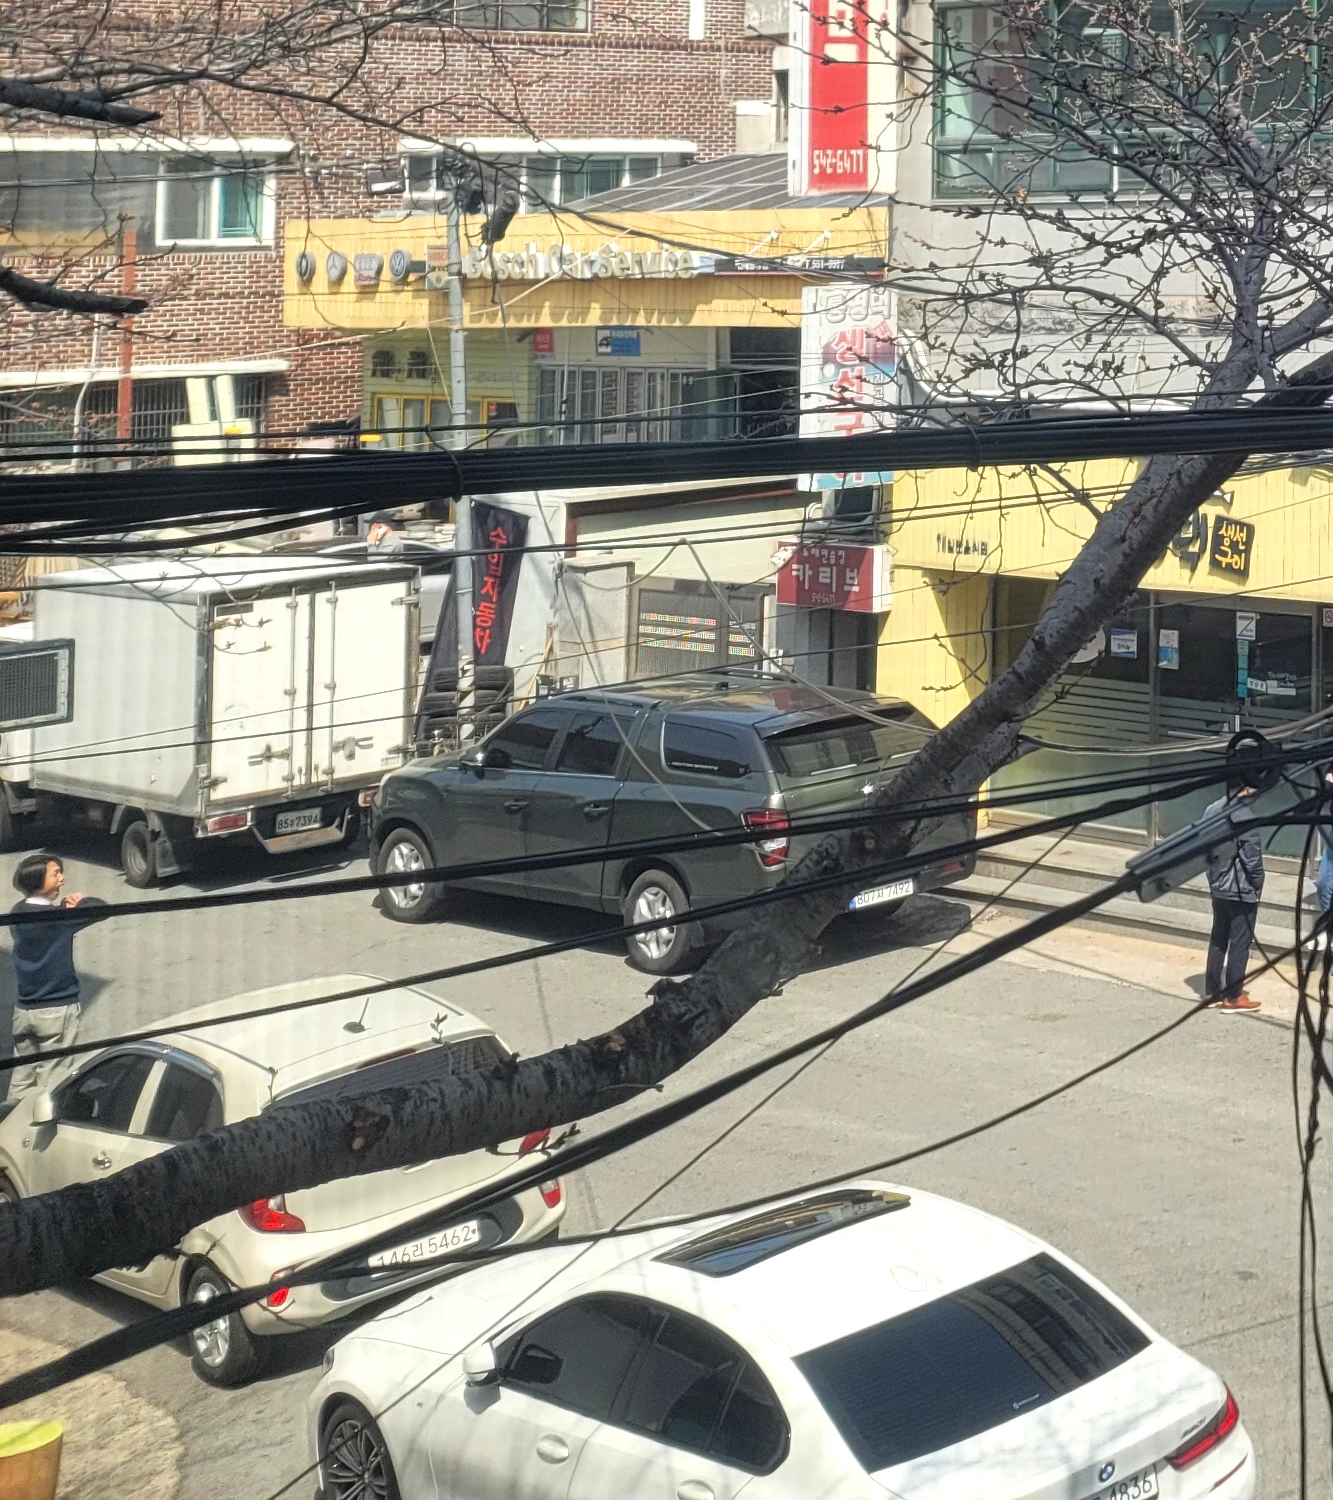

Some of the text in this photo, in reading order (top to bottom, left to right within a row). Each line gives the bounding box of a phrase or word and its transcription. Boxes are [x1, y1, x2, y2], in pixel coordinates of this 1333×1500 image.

[812, 149, 864, 175] 542-6477
[467, 241, 545, 280] Bosch
[600, 241, 700, 279] Service
[832, 328, 866, 481] 생선구
[1218, 520, 1247, 550] 생선
[1214, 546, 1246, 571] 구이
[791, 562, 859, 593] 카리브
